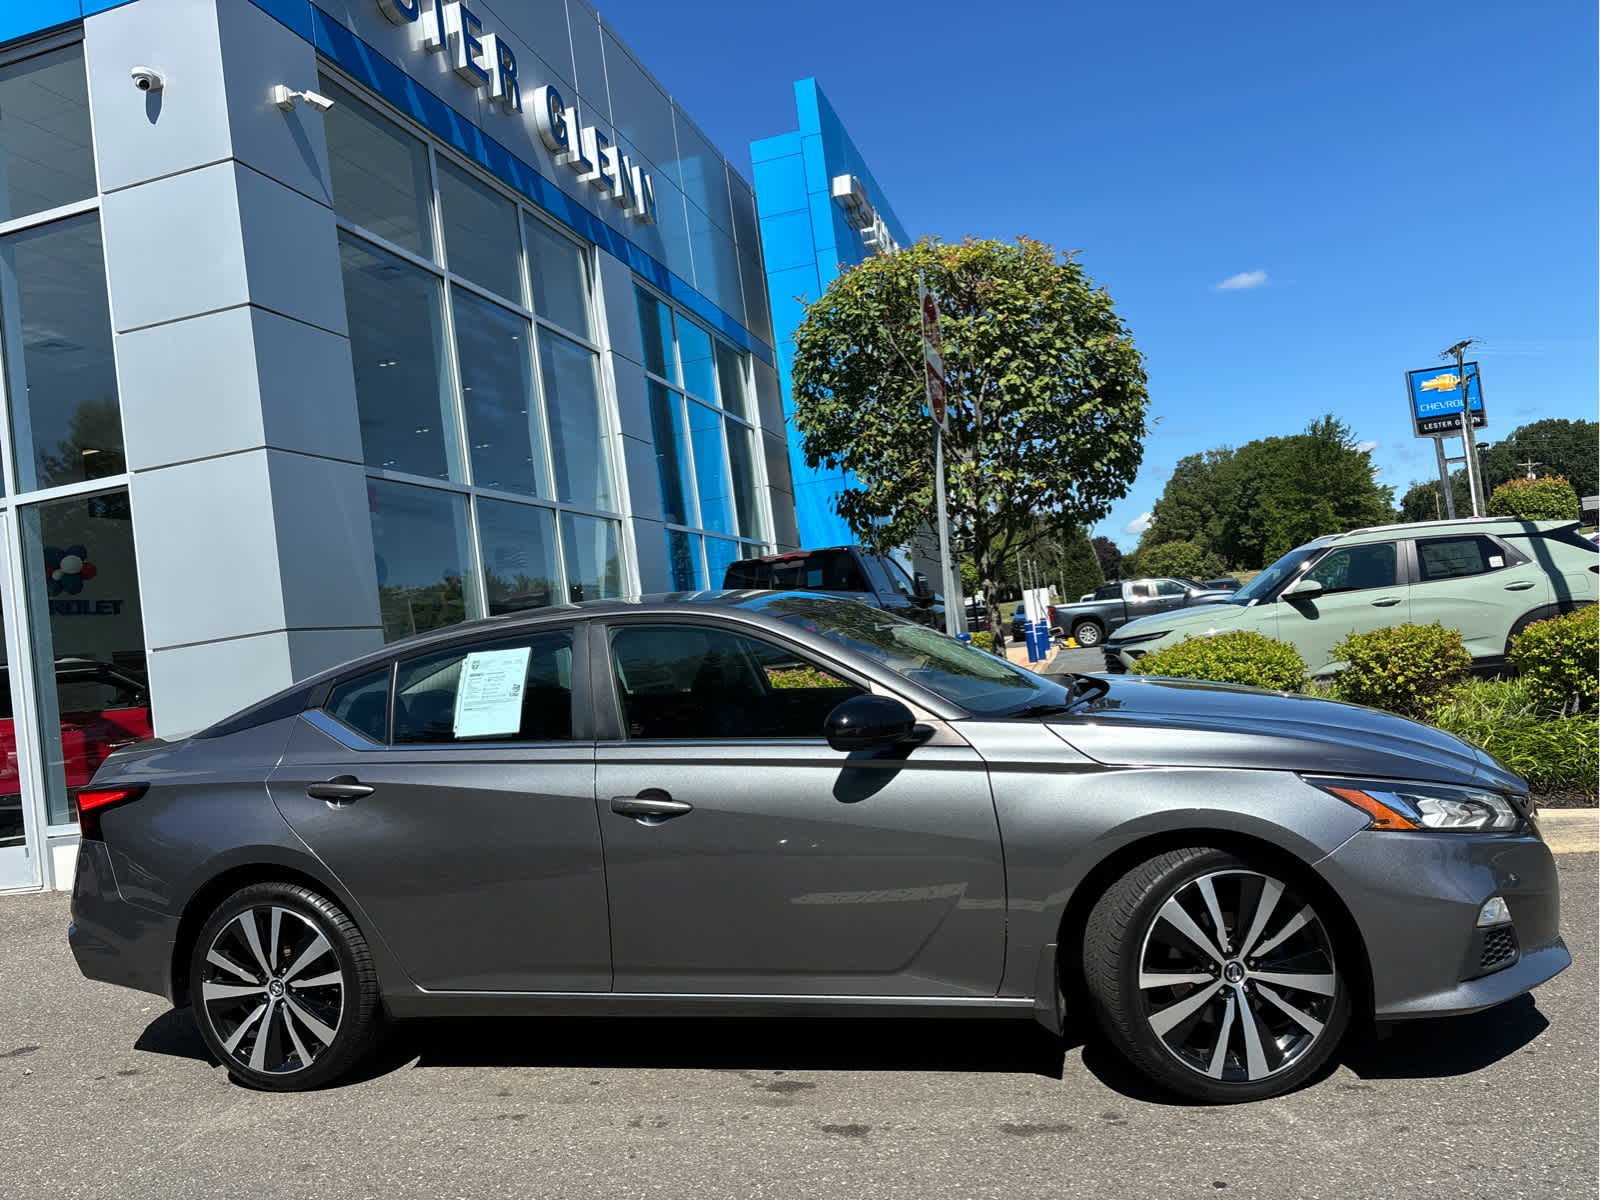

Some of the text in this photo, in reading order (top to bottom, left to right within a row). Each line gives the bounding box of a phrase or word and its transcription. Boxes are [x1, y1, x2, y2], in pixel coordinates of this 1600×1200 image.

[534, 85, 657, 224] GLENN
[1420, 396, 1478, 412] CHEVROLT
[1423, 420, 1453, 430] LESTER
